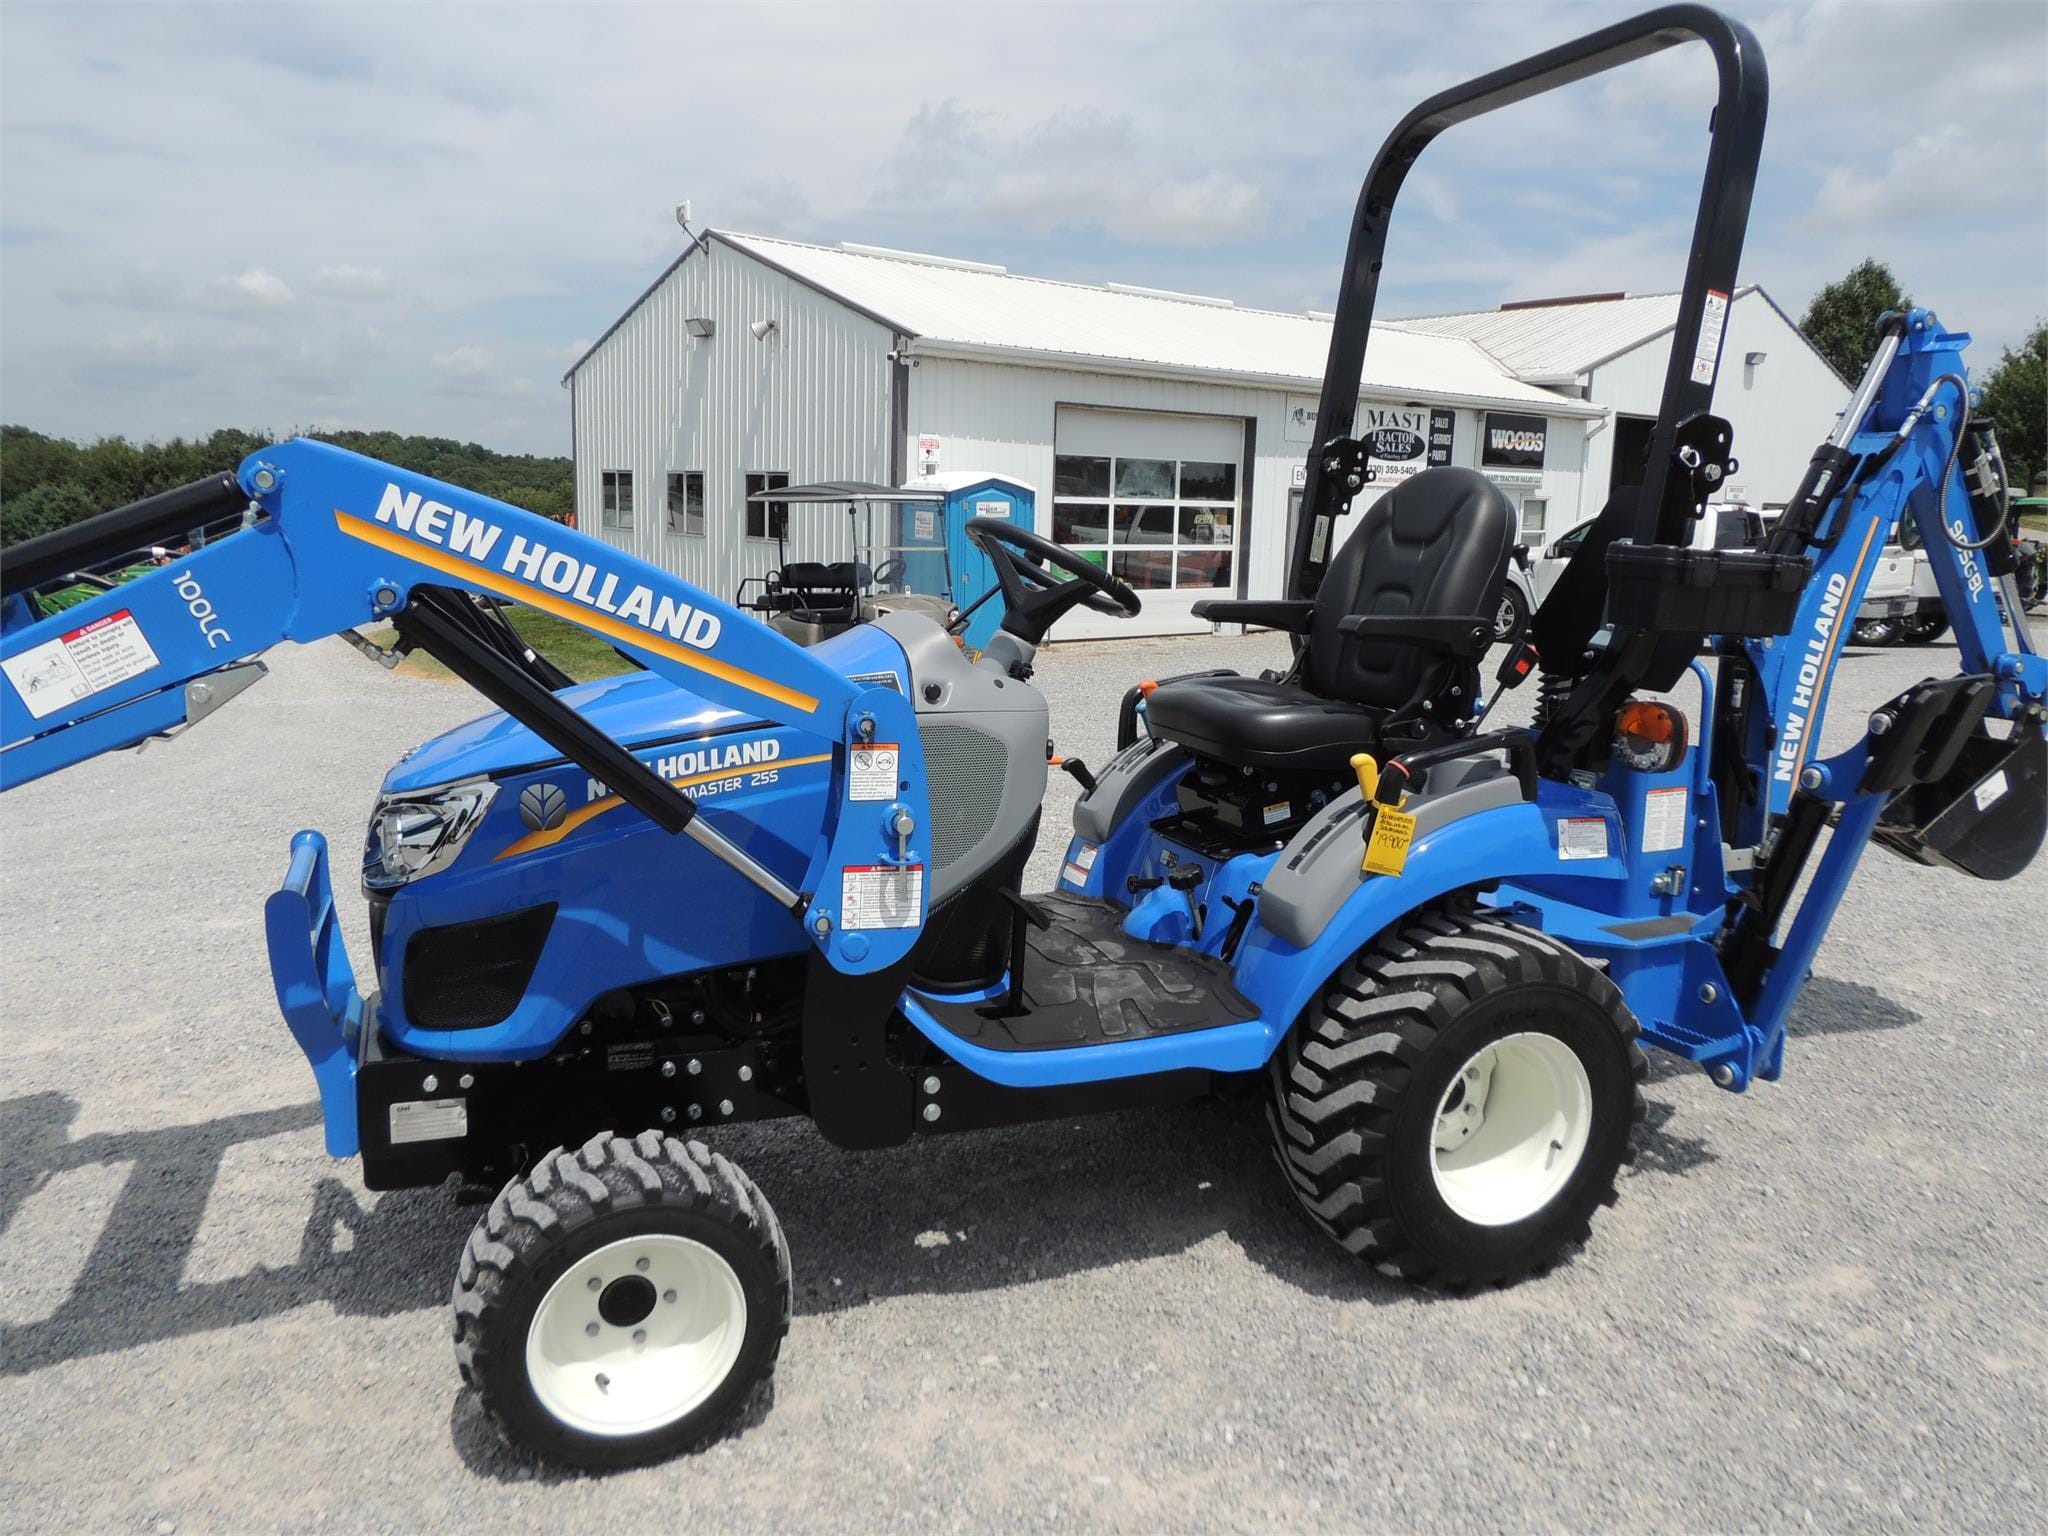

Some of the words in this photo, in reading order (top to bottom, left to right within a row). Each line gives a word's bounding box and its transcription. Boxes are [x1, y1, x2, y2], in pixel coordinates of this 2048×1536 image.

[1368, 410, 1425, 431] MAST
[1371, 430, 1415, 444] TRACTOR
[1375, 441, 1412, 453] SALES
[1491, 429, 1545, 452] WOODS
[1385, 465, 1418, 475] 359-5405
[375, 482, 503, 562] NEW
[502, 534, 722, 650] HOLLAND
[172, 570, 231, 648] 100LC
[1774, 712, 1805, 782] NEW
[1792, 573, 1847, 709] HOLLAND
[658, 739, 780, 779] HOLLAND
[682, 777, 742, 799] MASTER
[751, 770, 779, 787] 25S
